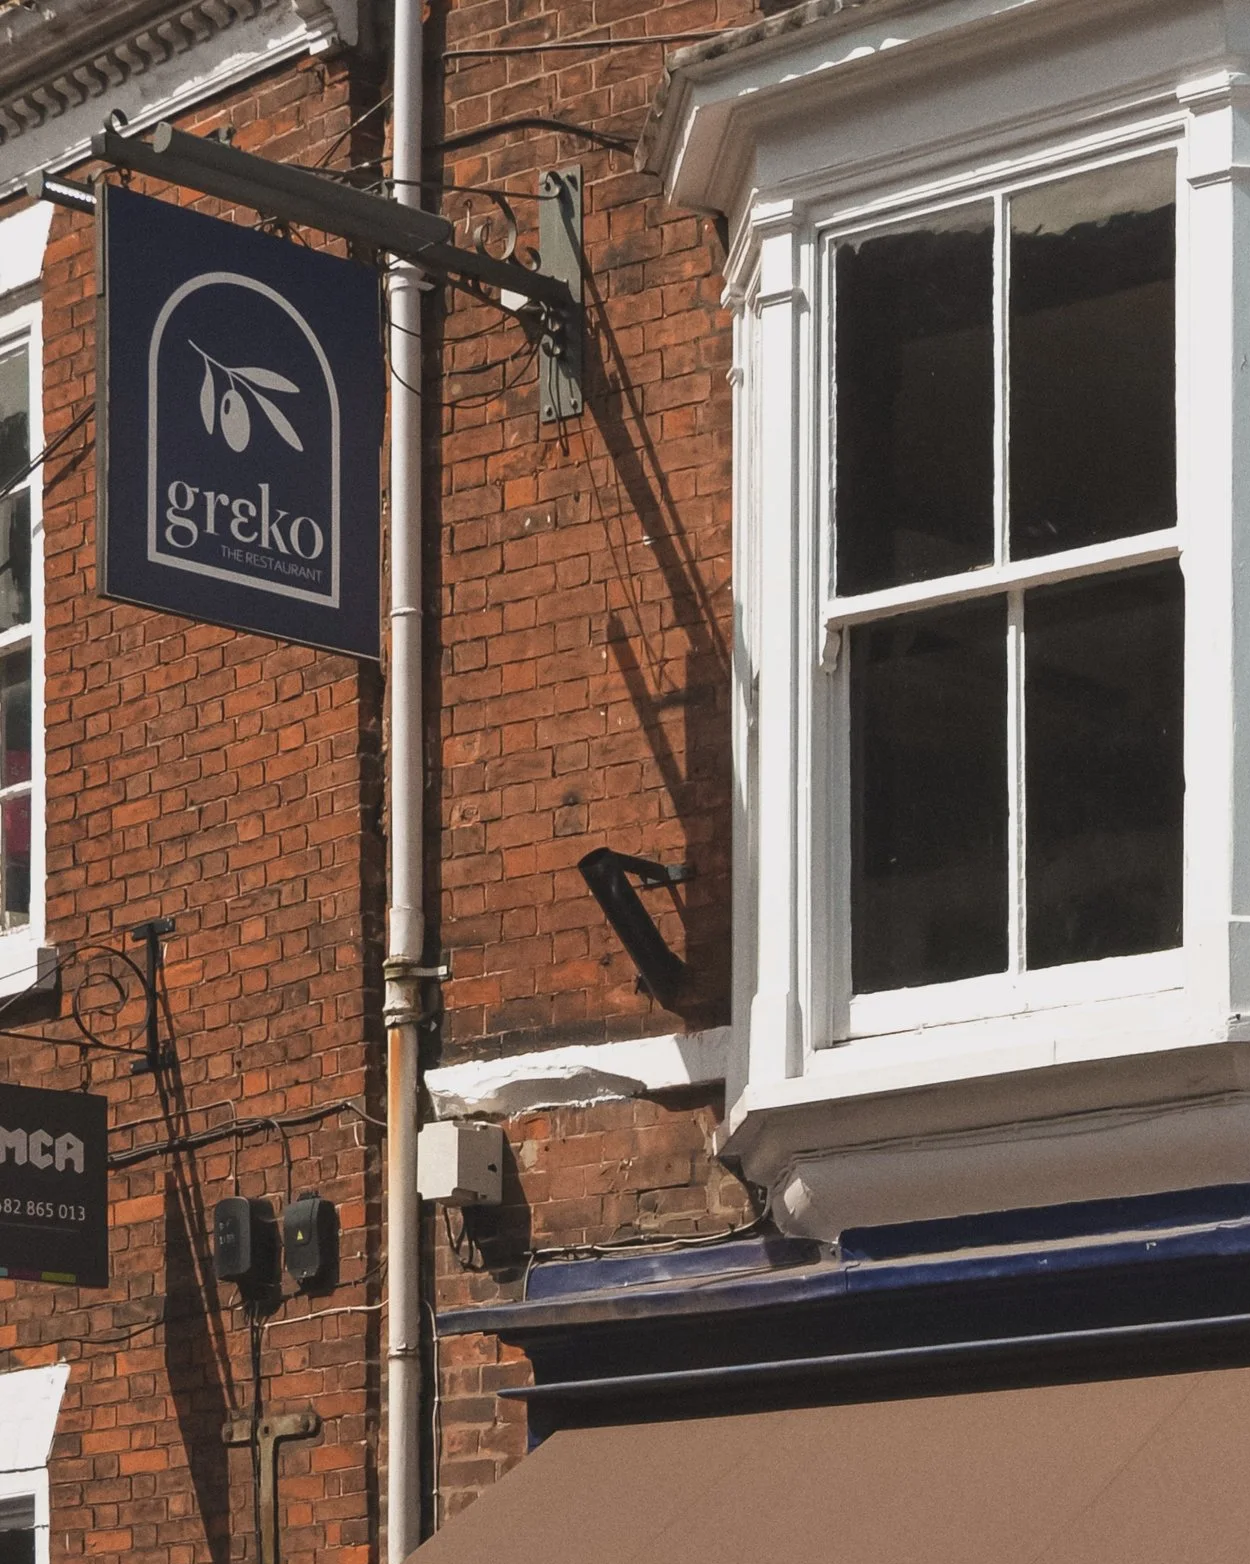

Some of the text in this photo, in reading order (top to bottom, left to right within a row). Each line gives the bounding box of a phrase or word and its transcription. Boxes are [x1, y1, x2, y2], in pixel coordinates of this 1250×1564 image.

[221, 544, 323, 583] THE RESTAURANT
[0, 1198, 86, 1222] 82 865 013
